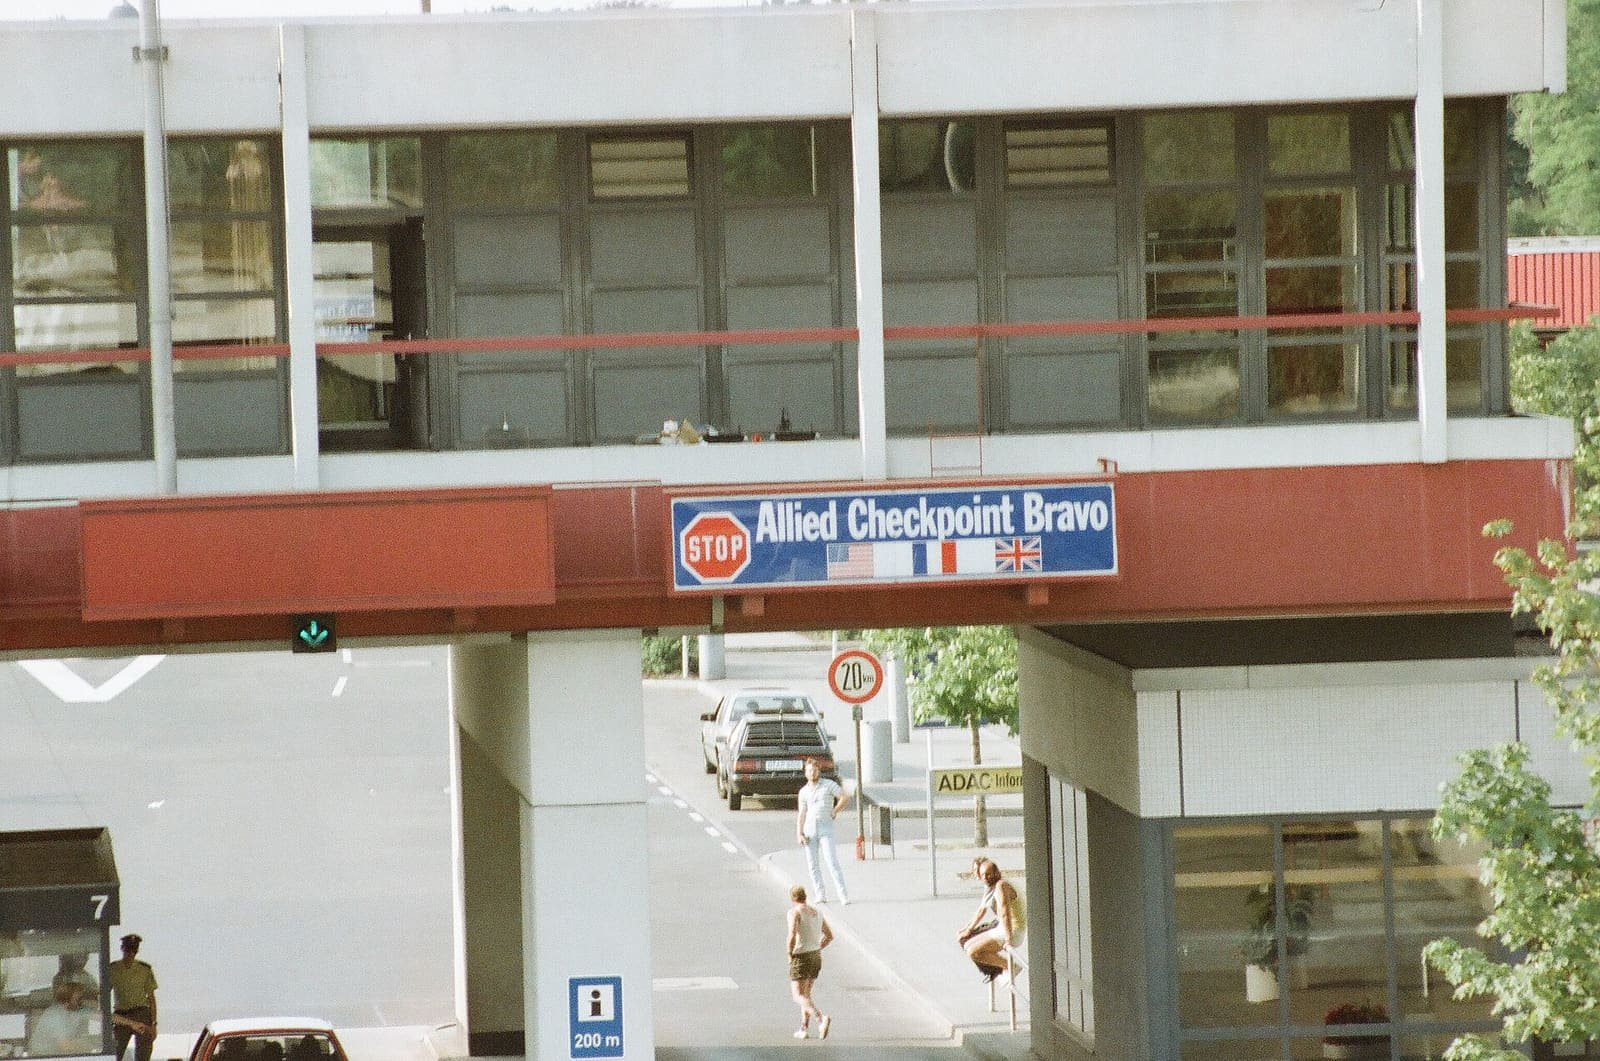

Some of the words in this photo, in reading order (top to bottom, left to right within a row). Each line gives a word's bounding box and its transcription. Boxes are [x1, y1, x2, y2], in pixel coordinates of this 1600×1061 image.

[755, 499, 838, 544] Allied
[847, 494, 1015, 540] Checkpoint
[1023, 491, 1109, 533] Bravo
[688, 533, 744, 563] STOP
[841, 662, 862, 690] 20
[938, 772, 991, 792] ADAC
[90, 894, 108, 920] 7
[574, 1032, 602, 1049] 200
[604, 1034, 620, 1048] m
